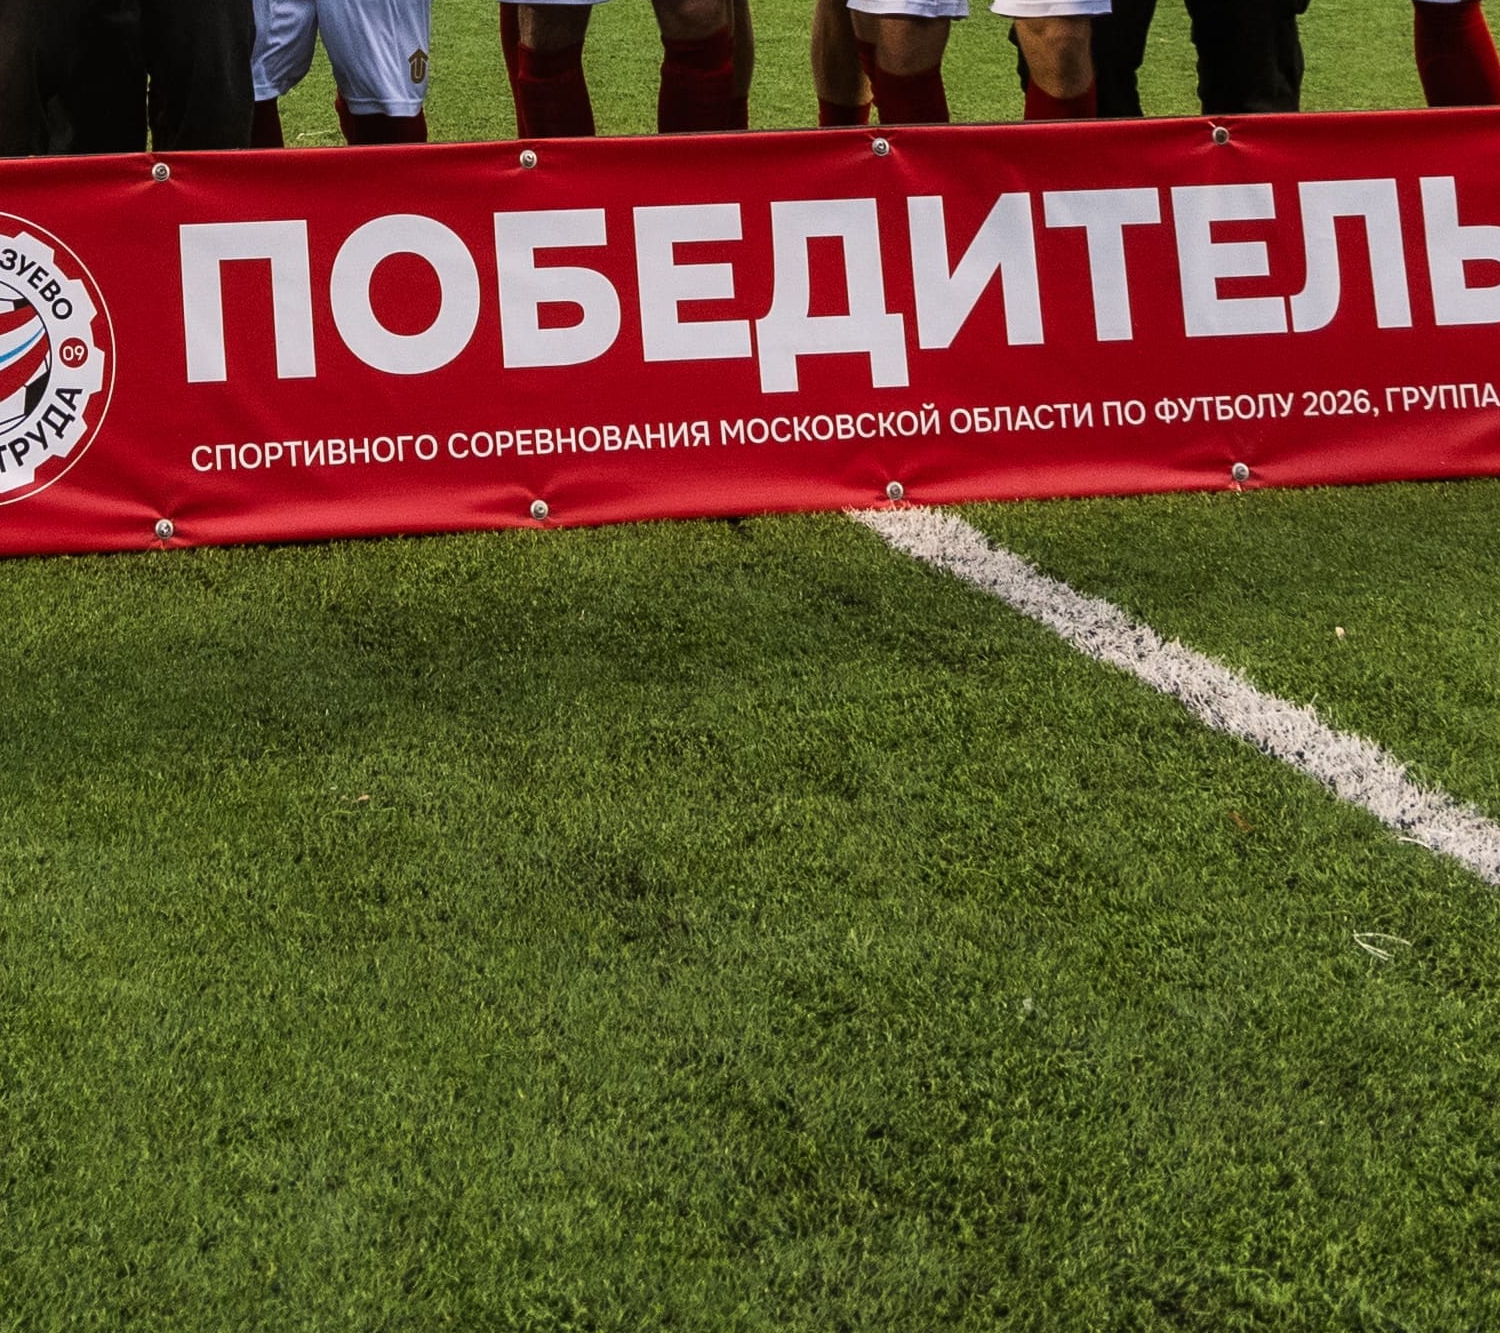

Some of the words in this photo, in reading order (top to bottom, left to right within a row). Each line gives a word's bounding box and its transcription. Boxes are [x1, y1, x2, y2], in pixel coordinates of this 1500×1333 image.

[62, 345, 85, 362] 09
[190, 434, 438, 472] СПОРТИВНОГО
[447, 420, 710, 459] СОРЕВНОВАНИЯ
[719, 402, 941, 446] МОСКОВСКОЙ
[950, 402, 1094, 434] ОБЛАСТИ
[1102, 399, 1146, 427] ПО
[1154, 392, 1294, 424] ФУТБОЛУ
[1302, 388, 1379, 418] 2026,
[1385, 382, 1500, 412] ГРУППА
